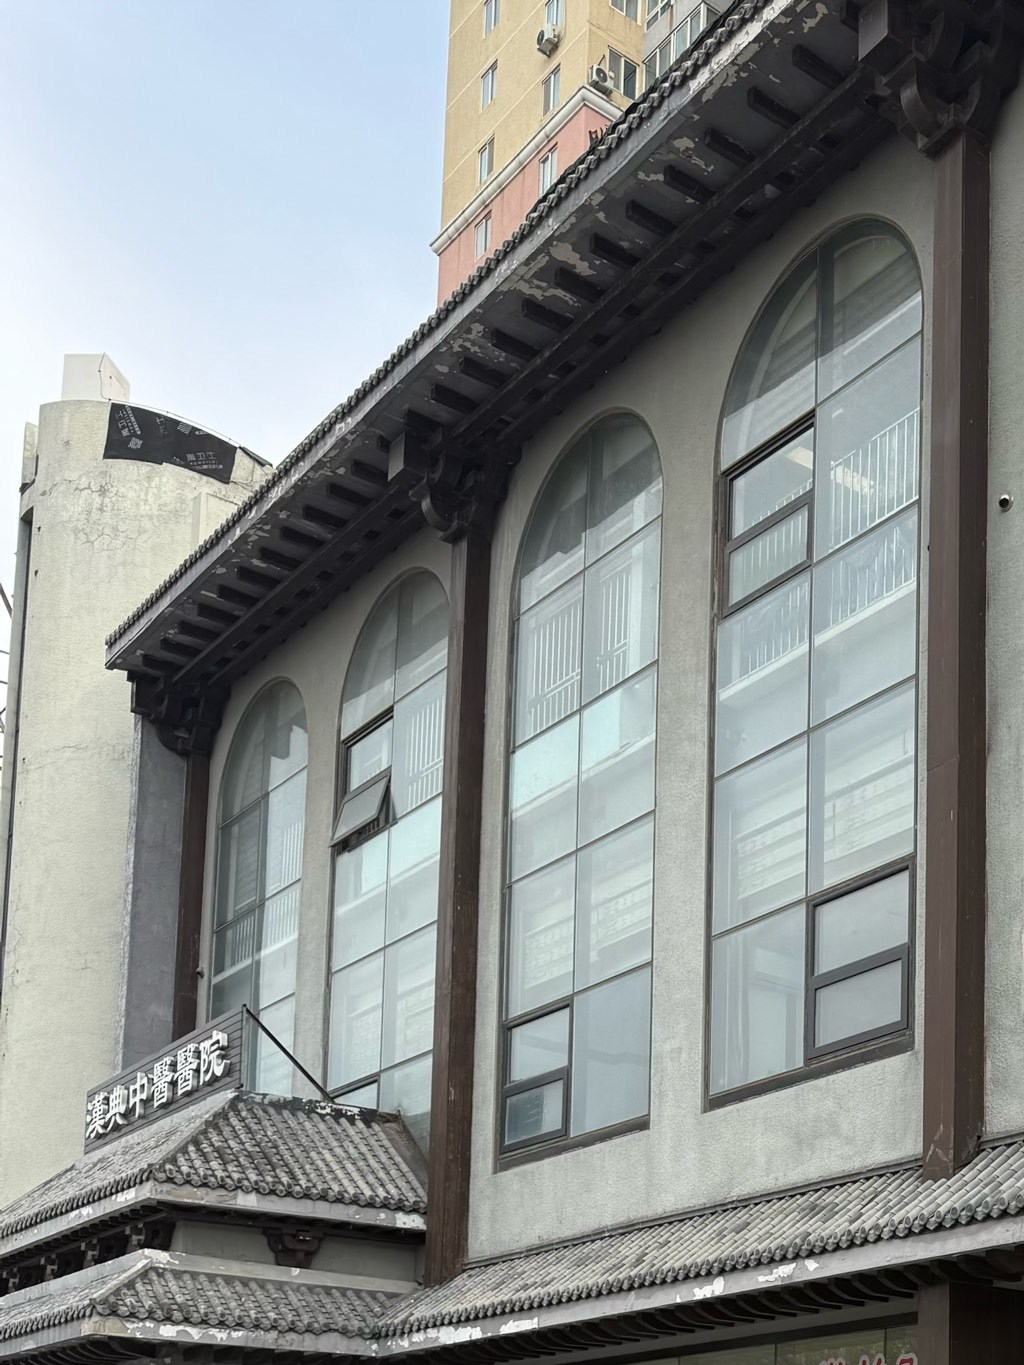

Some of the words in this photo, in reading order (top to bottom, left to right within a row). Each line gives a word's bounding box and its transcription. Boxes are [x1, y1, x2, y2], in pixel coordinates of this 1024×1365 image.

[85, 1029, 231, 1139] 漢典中醫醫院
